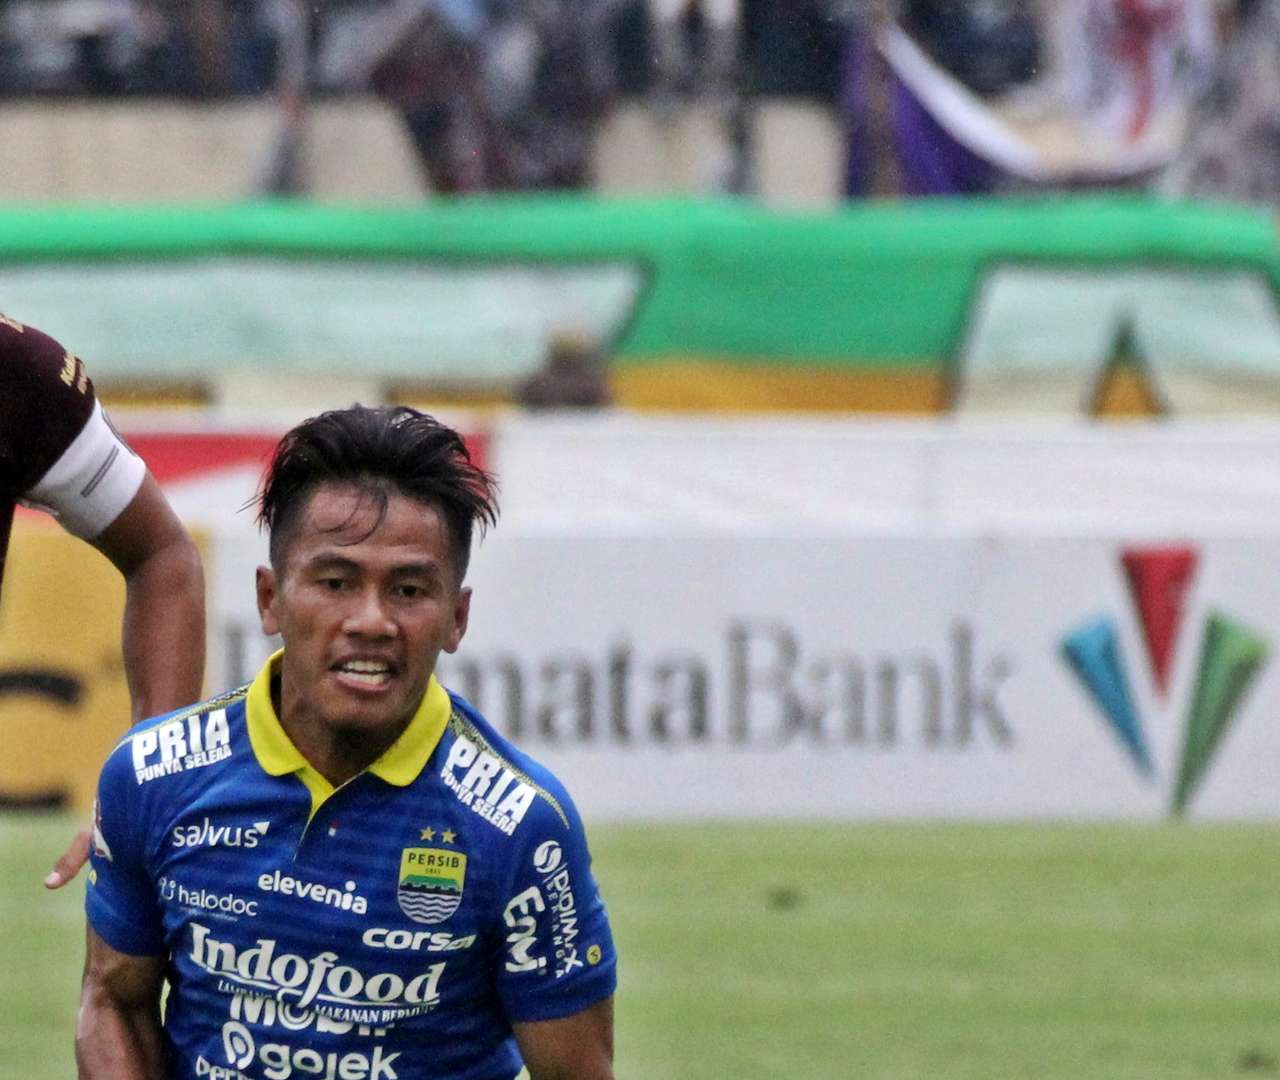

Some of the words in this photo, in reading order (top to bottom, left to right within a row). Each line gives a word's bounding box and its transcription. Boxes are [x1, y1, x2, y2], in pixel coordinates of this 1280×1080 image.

[132, 708, 230, 770] PRIA
[136, 757, 183, 785] PUNYA
[185, 744, 233, 769] SELERA
[448, 735, 537, 824] PRIA
[172, 817, 259, 848] salvus
[472, 798, 519, 836] SELERA
[408, 852, 460, 868] PERSIB
[178, 886, 259, 916] halodoc
[258, 870, 368, 915] elevenia
[362, 927, 477, 952] corsa
[189, 922, 447, 1009] Indofood
